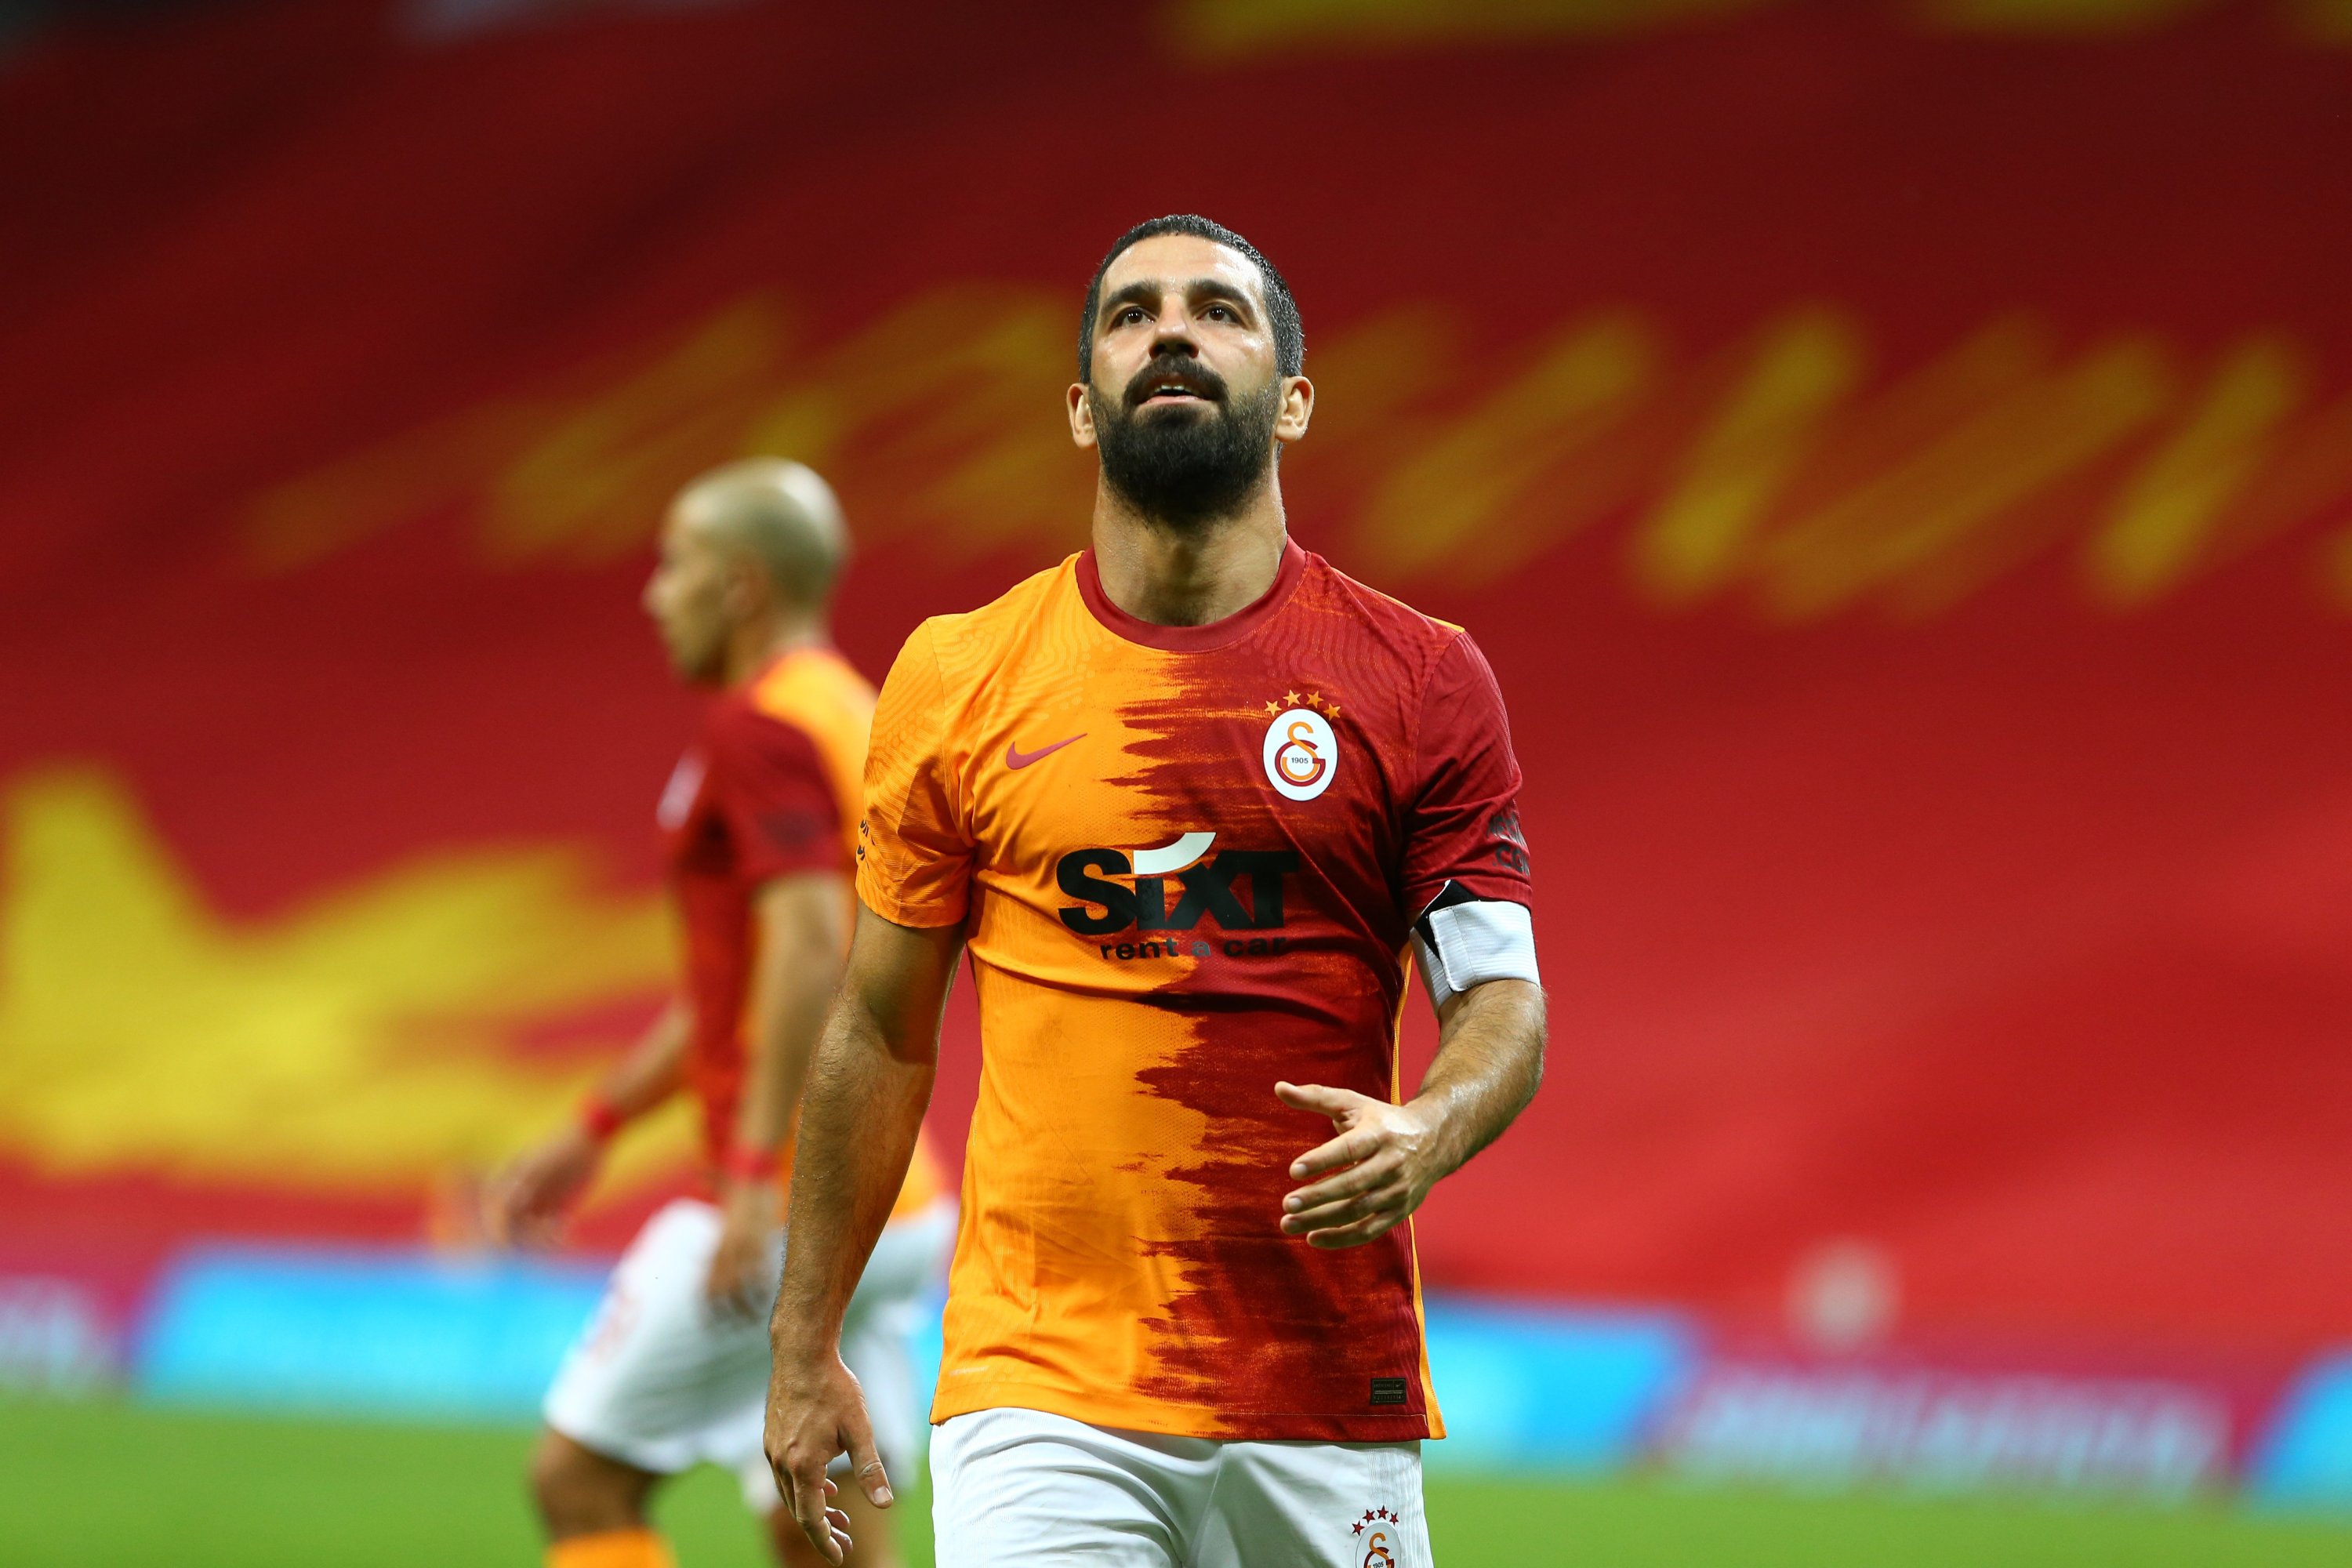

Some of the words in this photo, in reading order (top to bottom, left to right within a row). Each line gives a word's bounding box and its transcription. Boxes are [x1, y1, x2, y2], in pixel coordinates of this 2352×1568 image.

[1056, 832, 1299, 935] SIXT
[1100, 937, 1179, 960] rent
[1192, 940, 1211, 957] a
[1223, 937, 1287, 957] car
